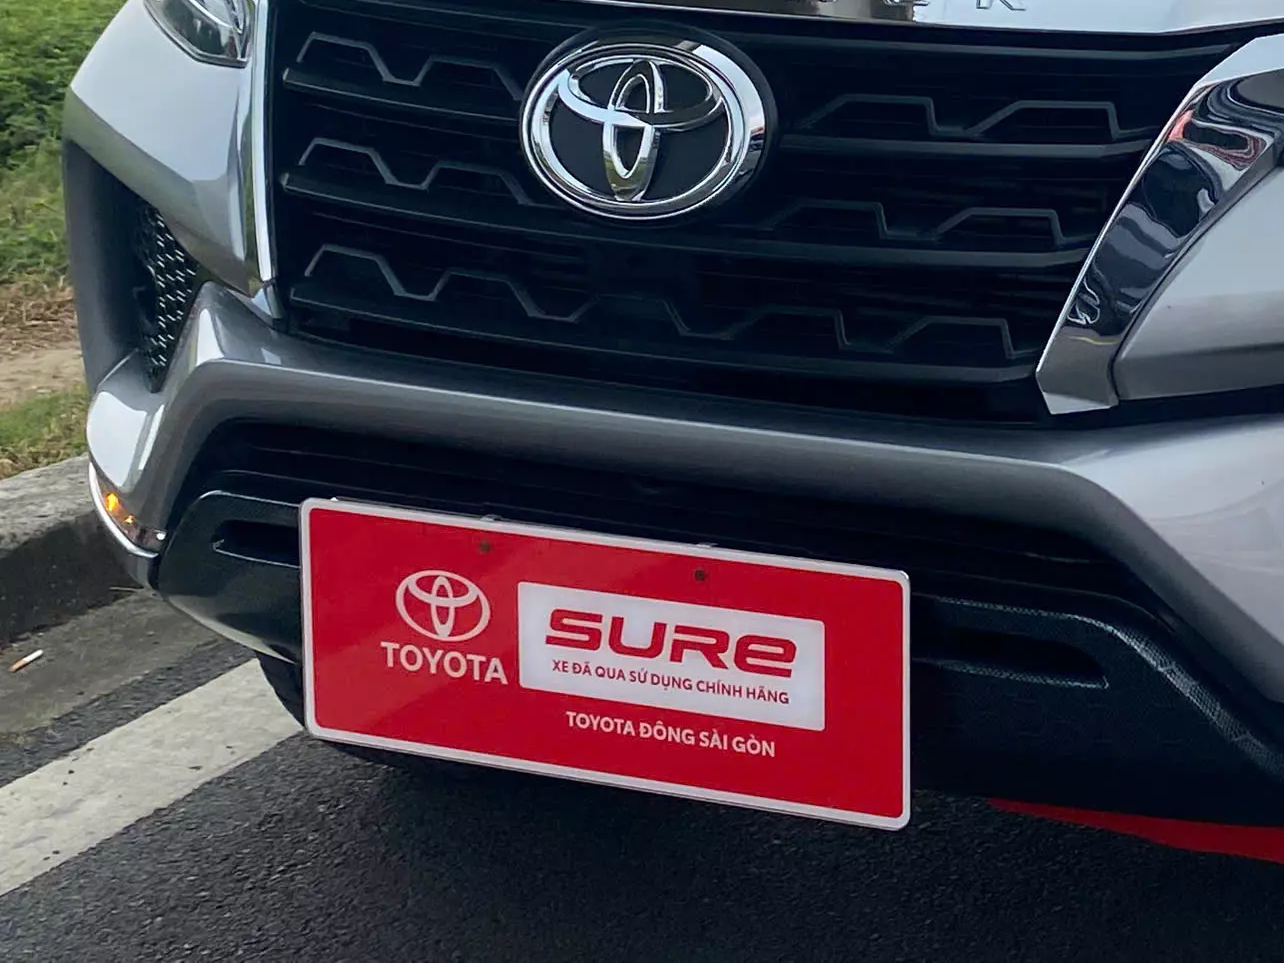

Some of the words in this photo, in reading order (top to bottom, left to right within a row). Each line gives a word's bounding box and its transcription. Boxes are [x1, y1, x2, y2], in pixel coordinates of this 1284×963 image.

[380, 641, 508, 685] TOYOTA
[552, 659, 569, 673] XE
[572, 661, 592, 676] ĐÃ
[595, 666, 626, 681] QUA
[651, 673, 693, 691] DỤNG
[696, 679, 742, 698] CHÍNH
[746, 686, 790, 704] HÃNG
[566, 711, 636, 736] TOYOTA
[639, 721, 696, 744] ĐÔNG
[699, 729, 728, 750] SÀI
[731, 734, 776, 757] GÒN
